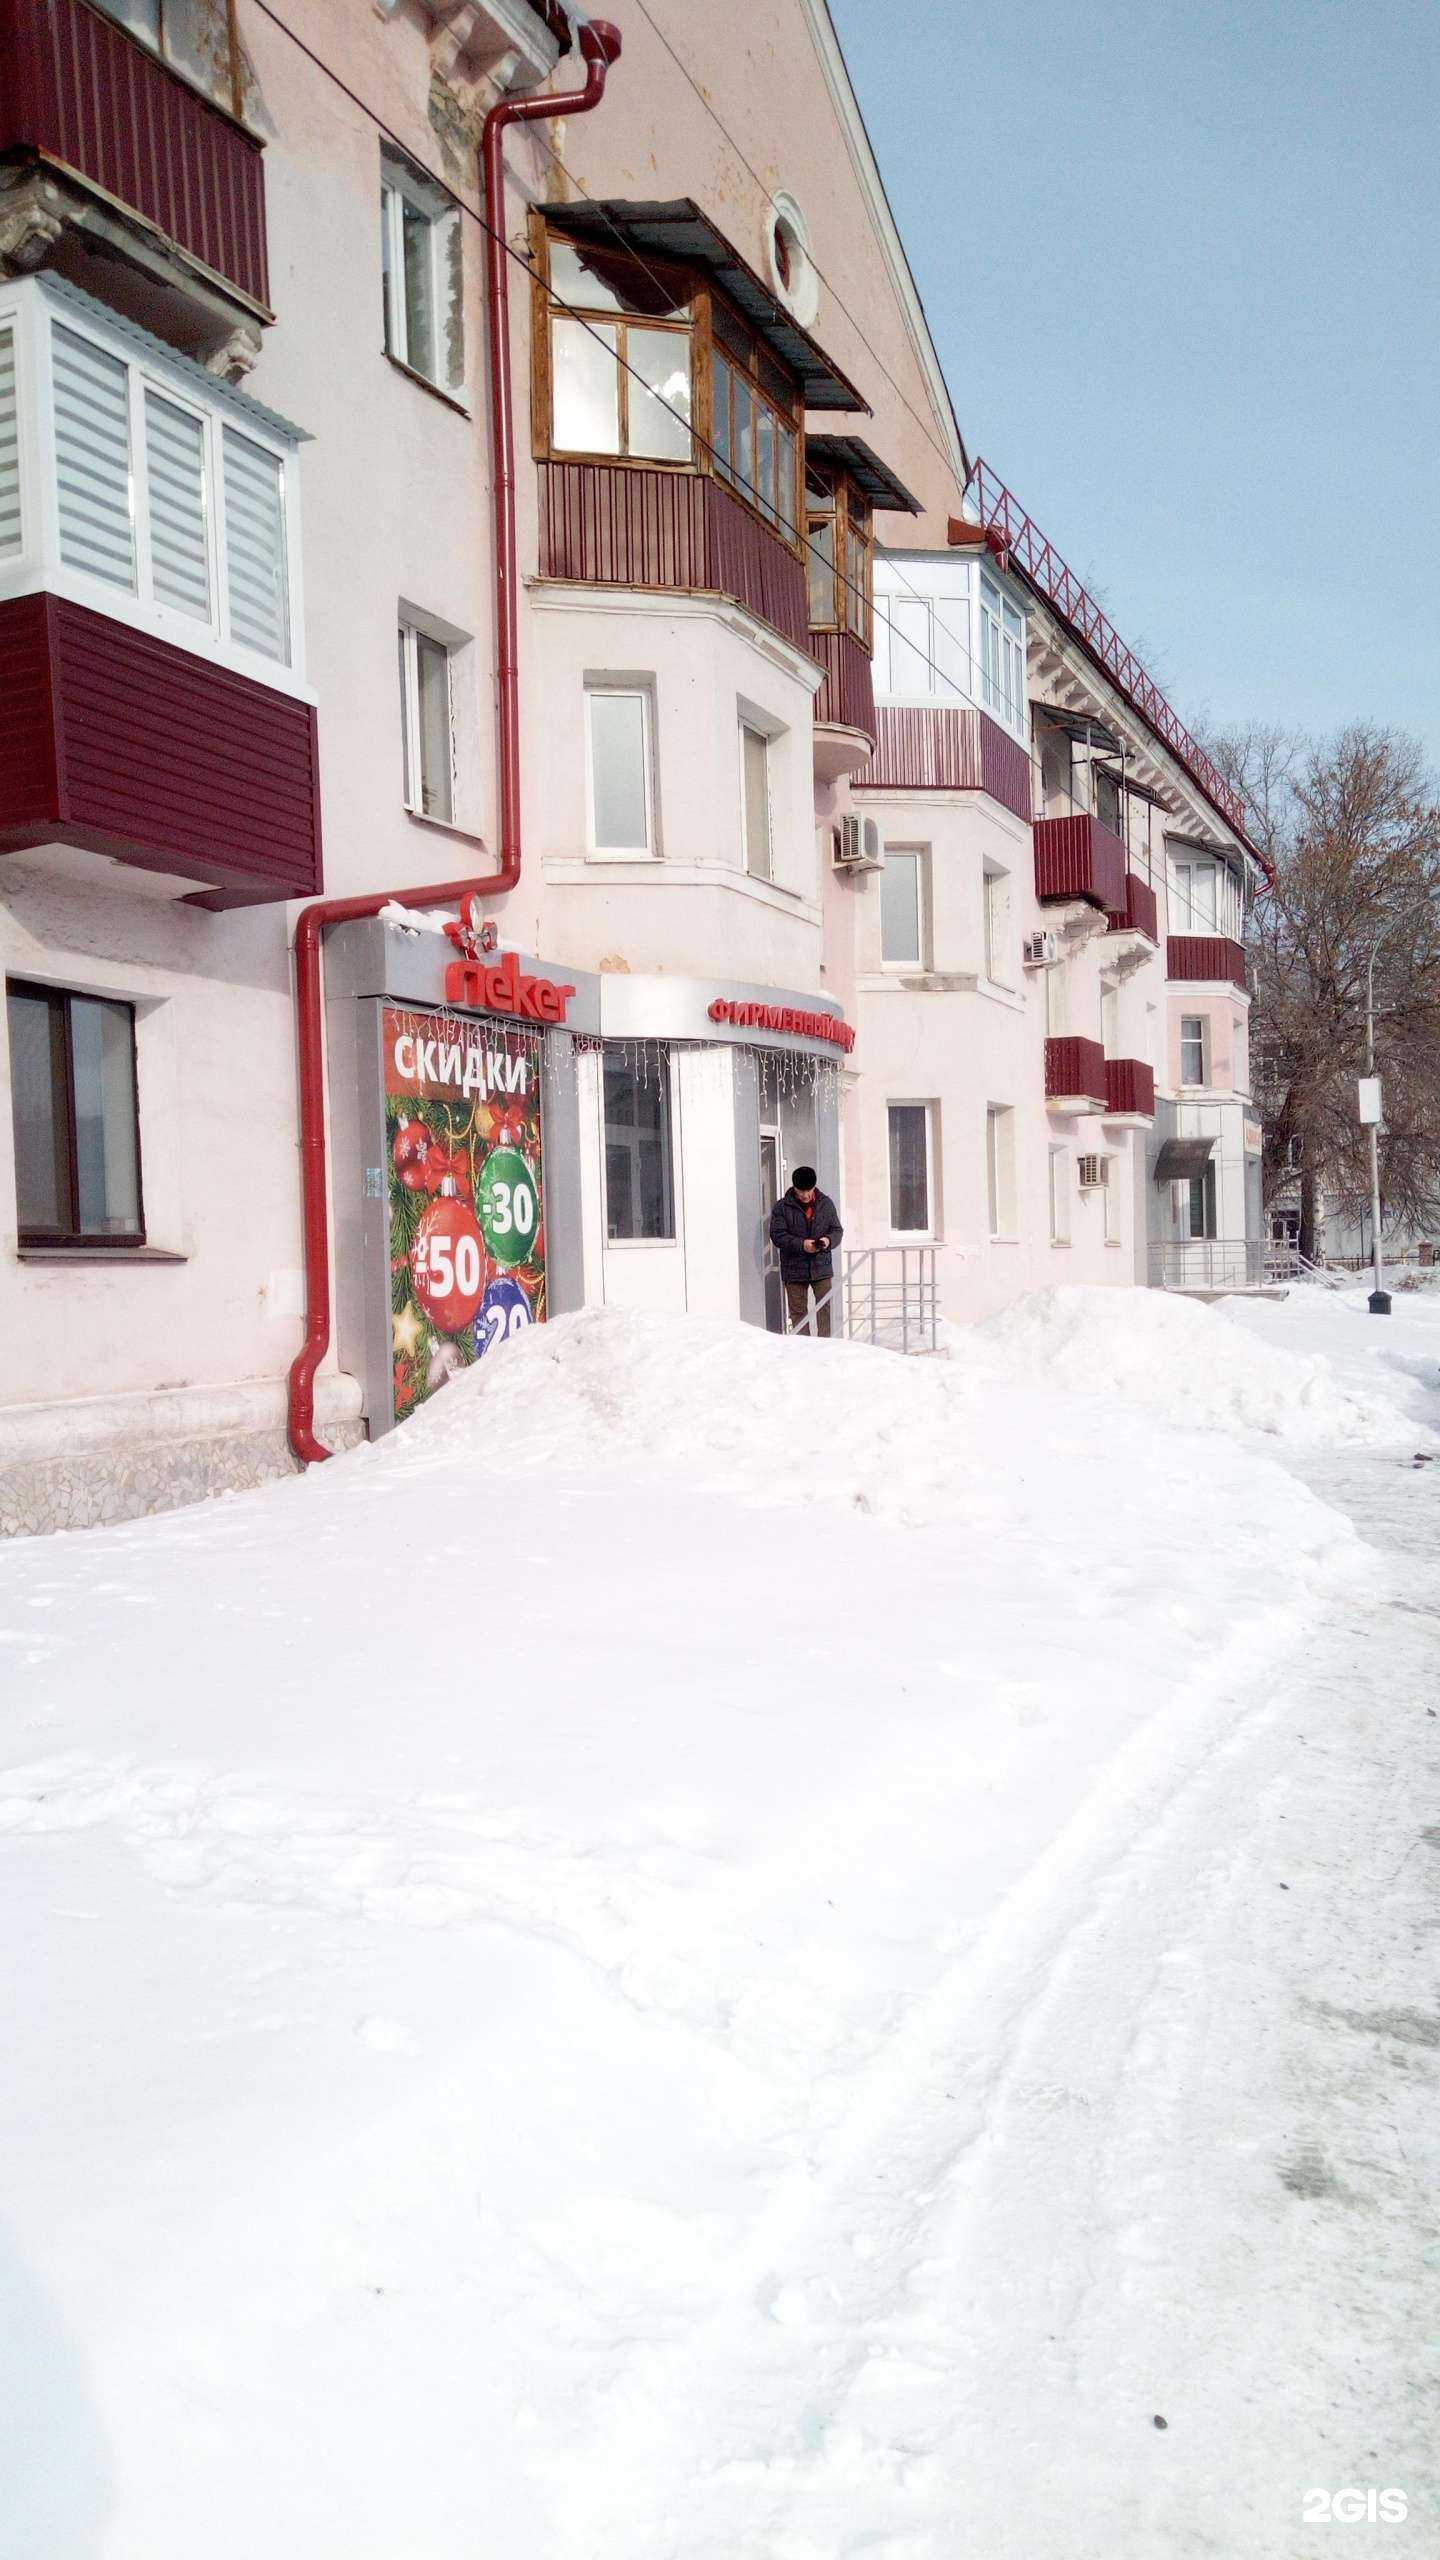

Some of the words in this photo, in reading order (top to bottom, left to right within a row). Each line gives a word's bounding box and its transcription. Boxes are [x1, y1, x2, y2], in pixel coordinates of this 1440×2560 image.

[707, 997, 834, 1042] ФИРМЕННЫЙ
[394, 1033, 527, 1101] СКИДКИ
[482, 1182, 534, 1235] -30
[415, 1235, 480, 1298] -50
